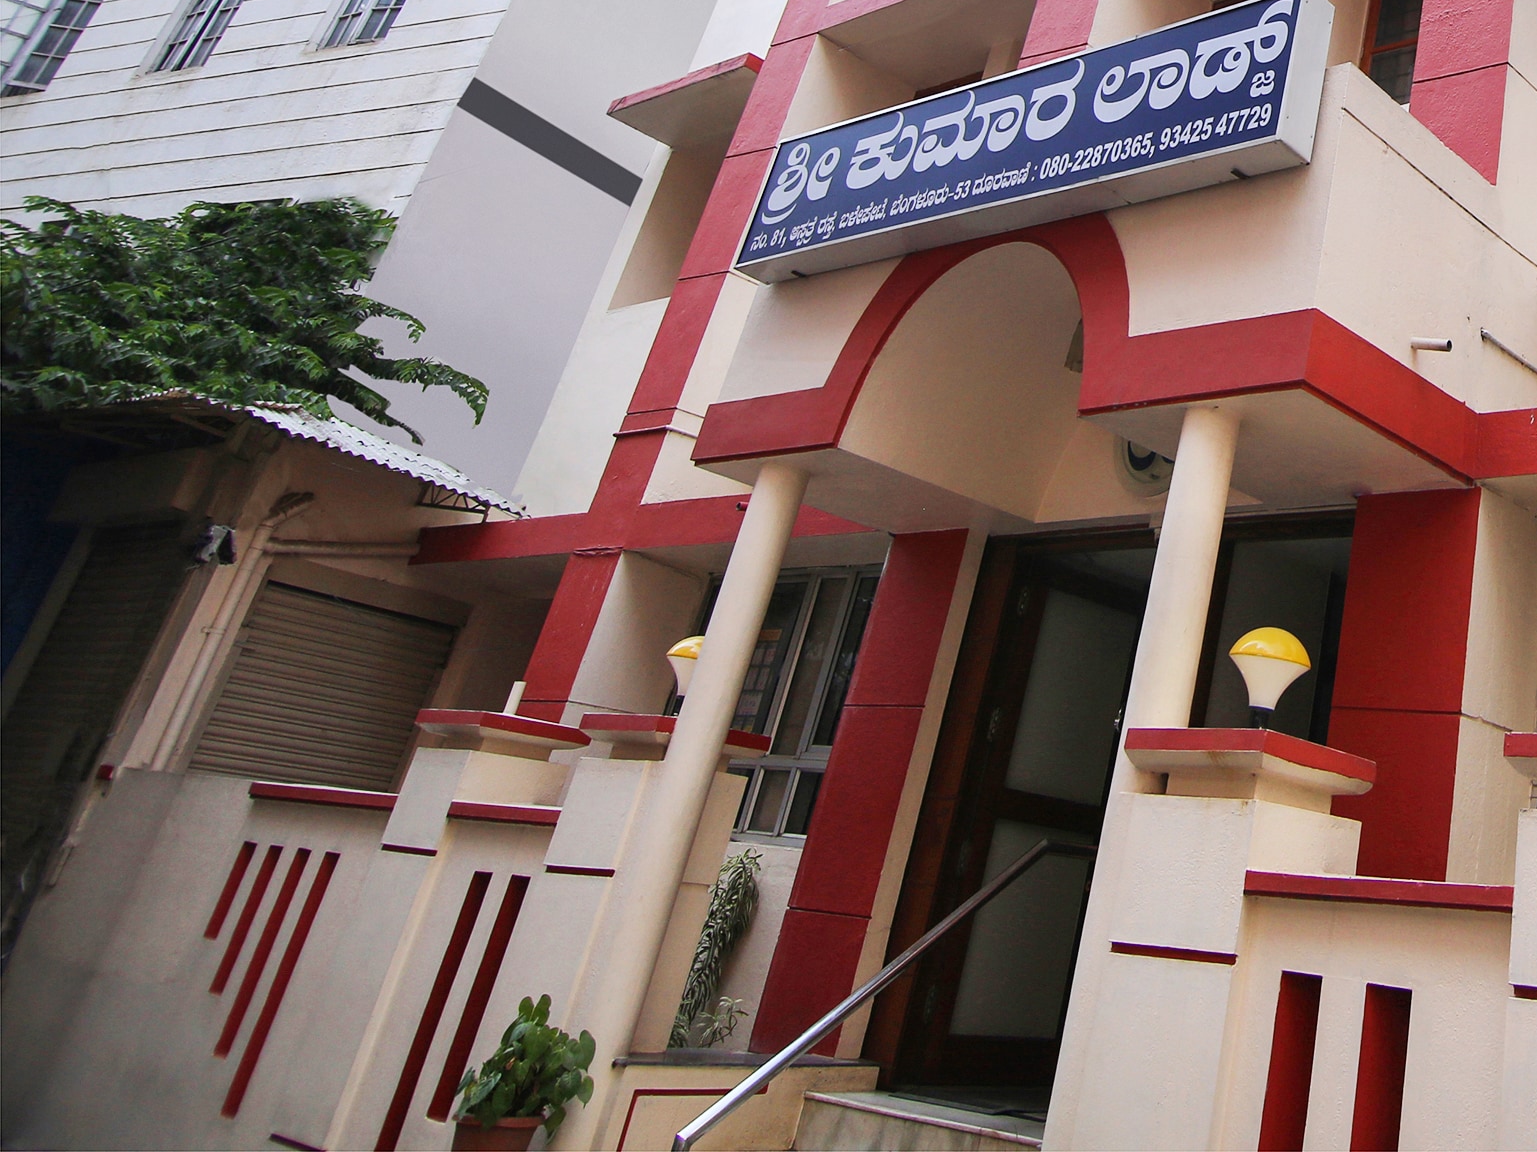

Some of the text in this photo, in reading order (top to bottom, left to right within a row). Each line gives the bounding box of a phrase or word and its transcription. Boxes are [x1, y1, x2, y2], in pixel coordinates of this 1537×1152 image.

[762, 142, 841, 225] ಶ್ರೀ
[846, 58, 1086, 190] ಕುಮಾರ
[770, 227, 787, 248] 81,
[1039, 133, 1156, 180] 080-22870365,
[1159, 117, 1214, 151] 93425
[1214, 103, 1272, 136] 47729
